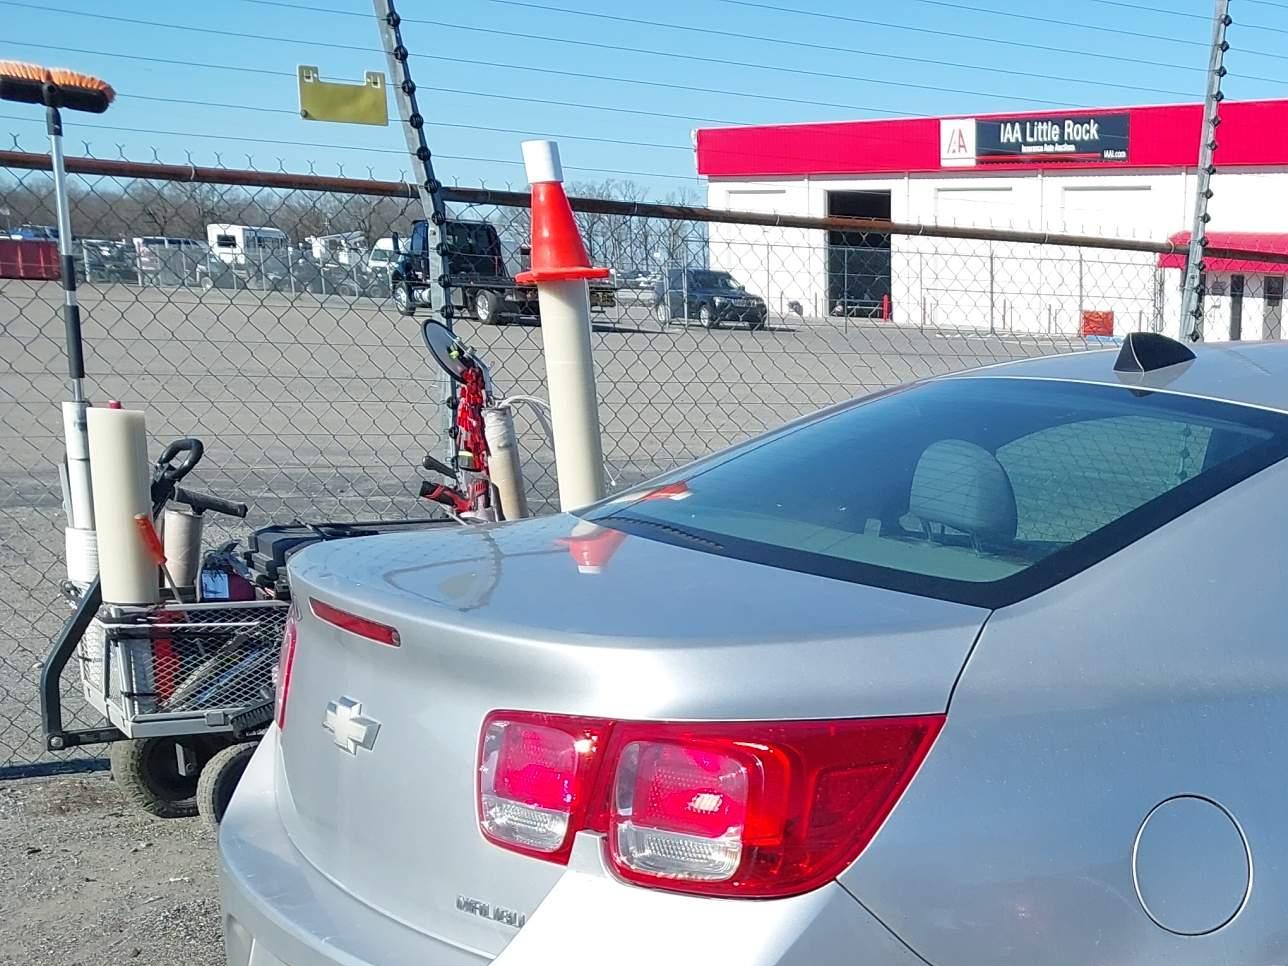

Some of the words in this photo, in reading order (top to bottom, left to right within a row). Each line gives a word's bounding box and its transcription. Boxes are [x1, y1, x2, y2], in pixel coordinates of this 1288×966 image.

[1001, 123, 1022, 143] IAA
[1026, 120, 1059, 142] Little
[1064, 119, 1099, 141] Rock
